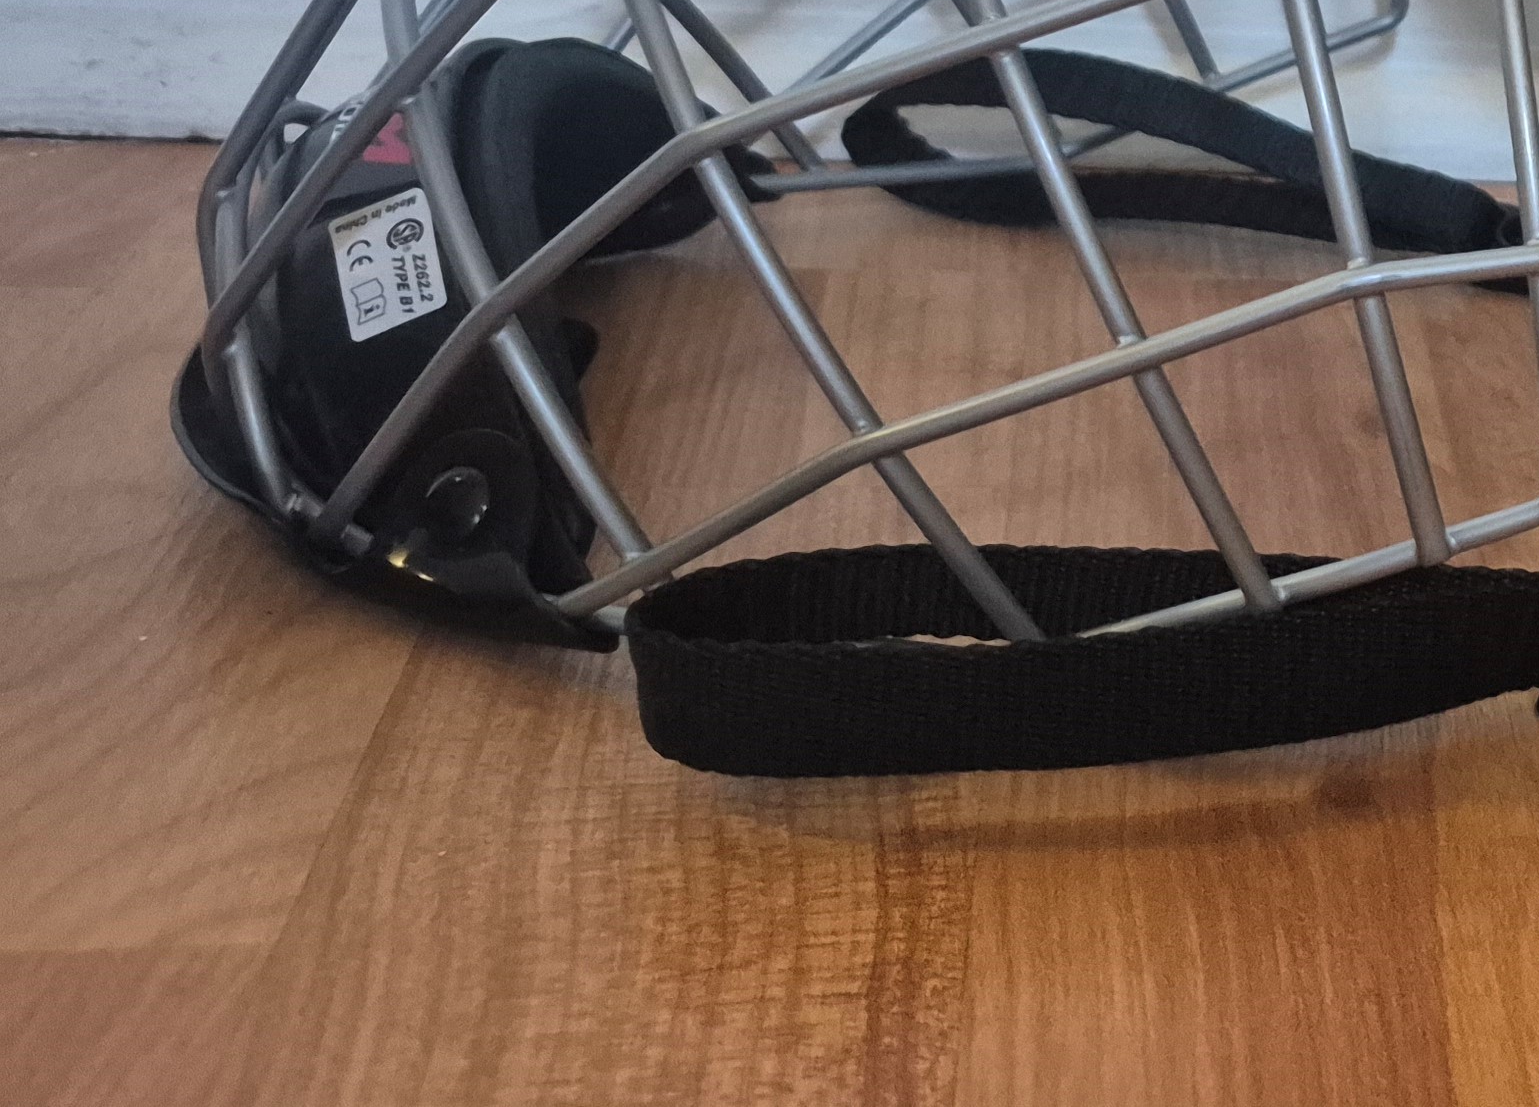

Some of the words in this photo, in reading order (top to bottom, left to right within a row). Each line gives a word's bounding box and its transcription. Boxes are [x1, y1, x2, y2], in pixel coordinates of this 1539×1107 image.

[385, 195, 417, 213] Made
[334, 214, 367, 233] China
[391, 256, 411, 292] TYPE
[412, 253, 434, 302] Z262.2
[400, 296, 417, 314] B1
